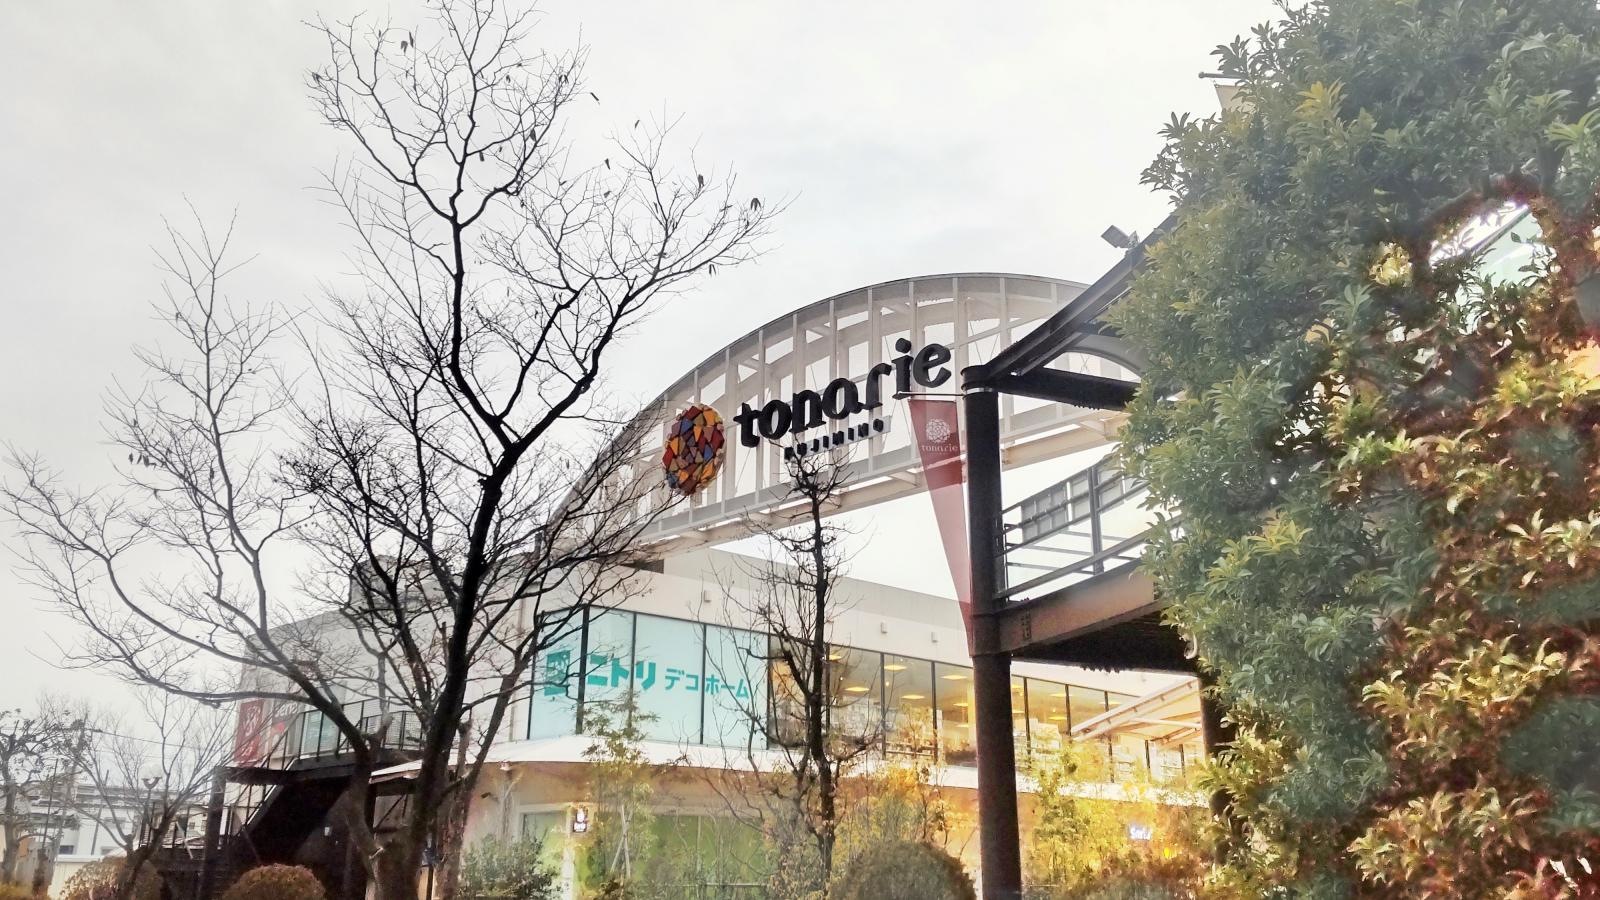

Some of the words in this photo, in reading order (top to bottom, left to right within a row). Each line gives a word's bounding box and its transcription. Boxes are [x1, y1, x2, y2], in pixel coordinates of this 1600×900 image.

[734, 338, 951, 447] tonarie
[921, 444, 959, 453] tonarie
[586, 653, 656, 690] ニトリ
[665, 669, 749, 699] デコホーム
